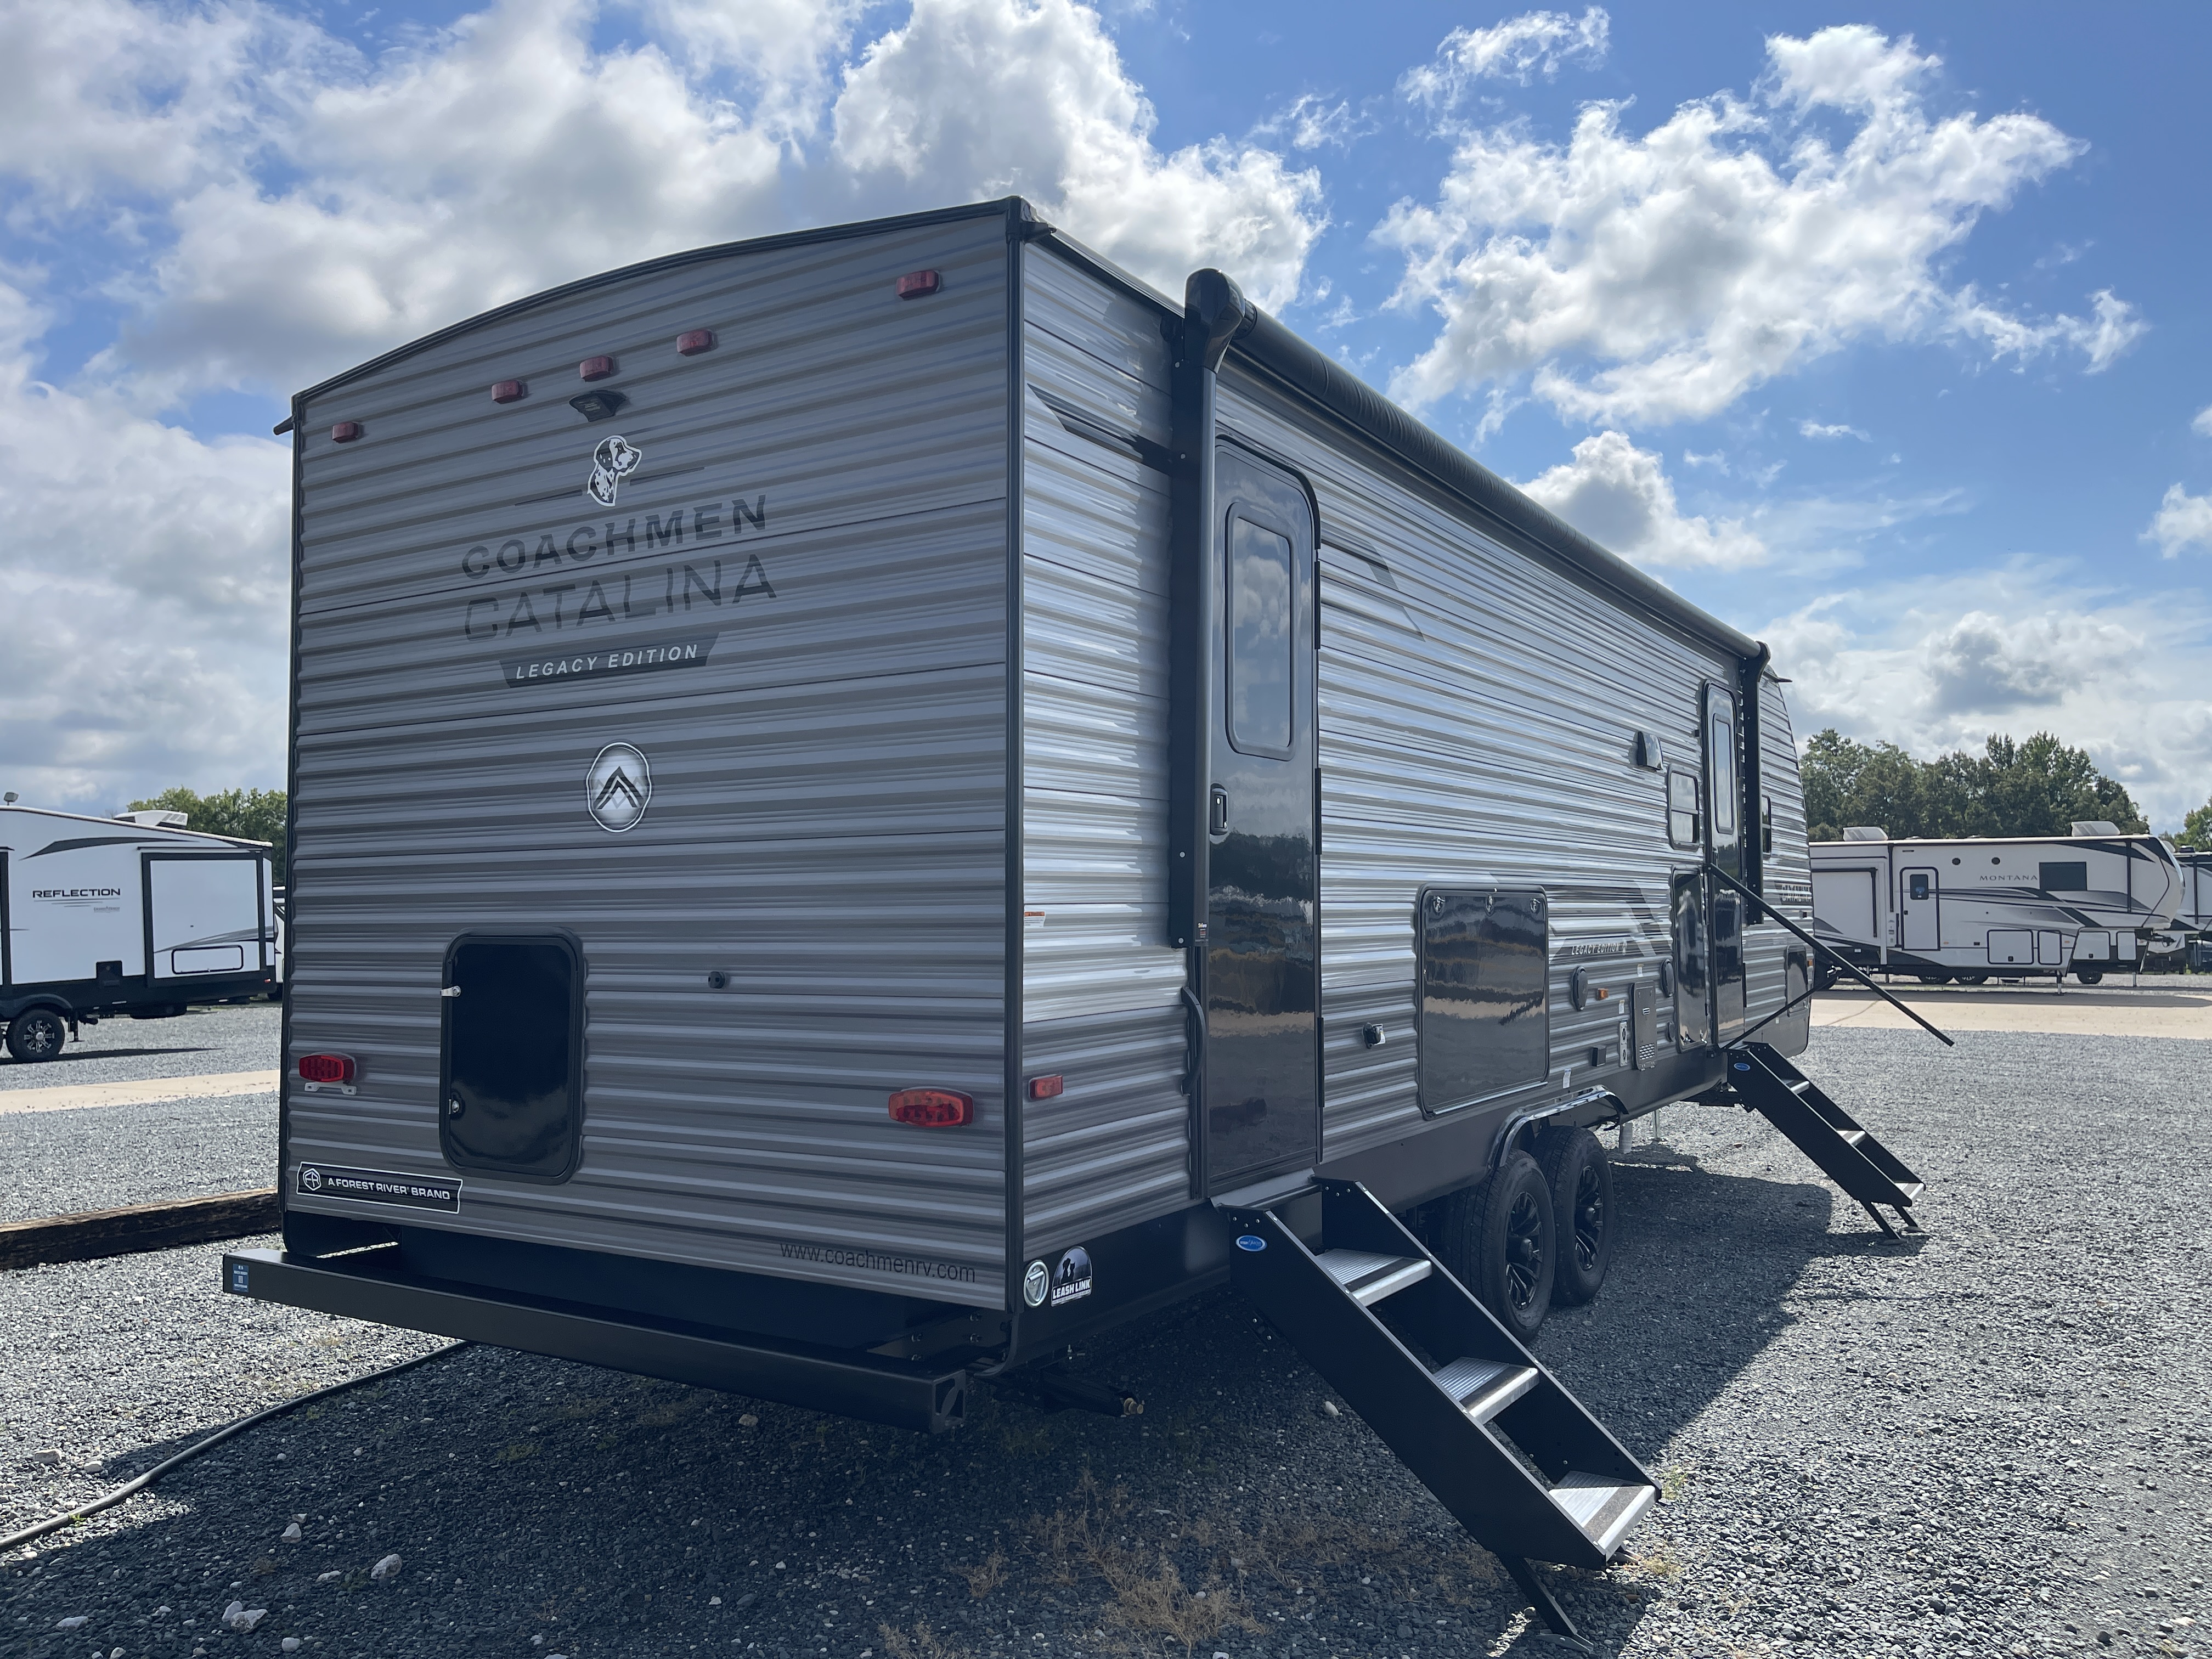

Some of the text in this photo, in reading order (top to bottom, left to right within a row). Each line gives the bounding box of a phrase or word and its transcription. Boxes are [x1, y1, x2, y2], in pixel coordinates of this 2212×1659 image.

[462, 494, 766, 579] COACHMEN
[464, 554, 777, 642] CATALINA
[516, 644, 697, 679] LEGACY EDITION
[32, 888, 121, 898] REFLECTION
[1571, 943, 1620, 955] LEGACY EDITION
[328, 1177, 336, 1186] A
[336, 1178, 375, 1191] FOREST
[411, 1188, 450, 1200] BRAND
[780, 1243, 975, 1283] www.coachmenrv.com
[1053, 1283, 1075, 1300] LEASH
[1075, 1278, 1091, 1293] LINK
